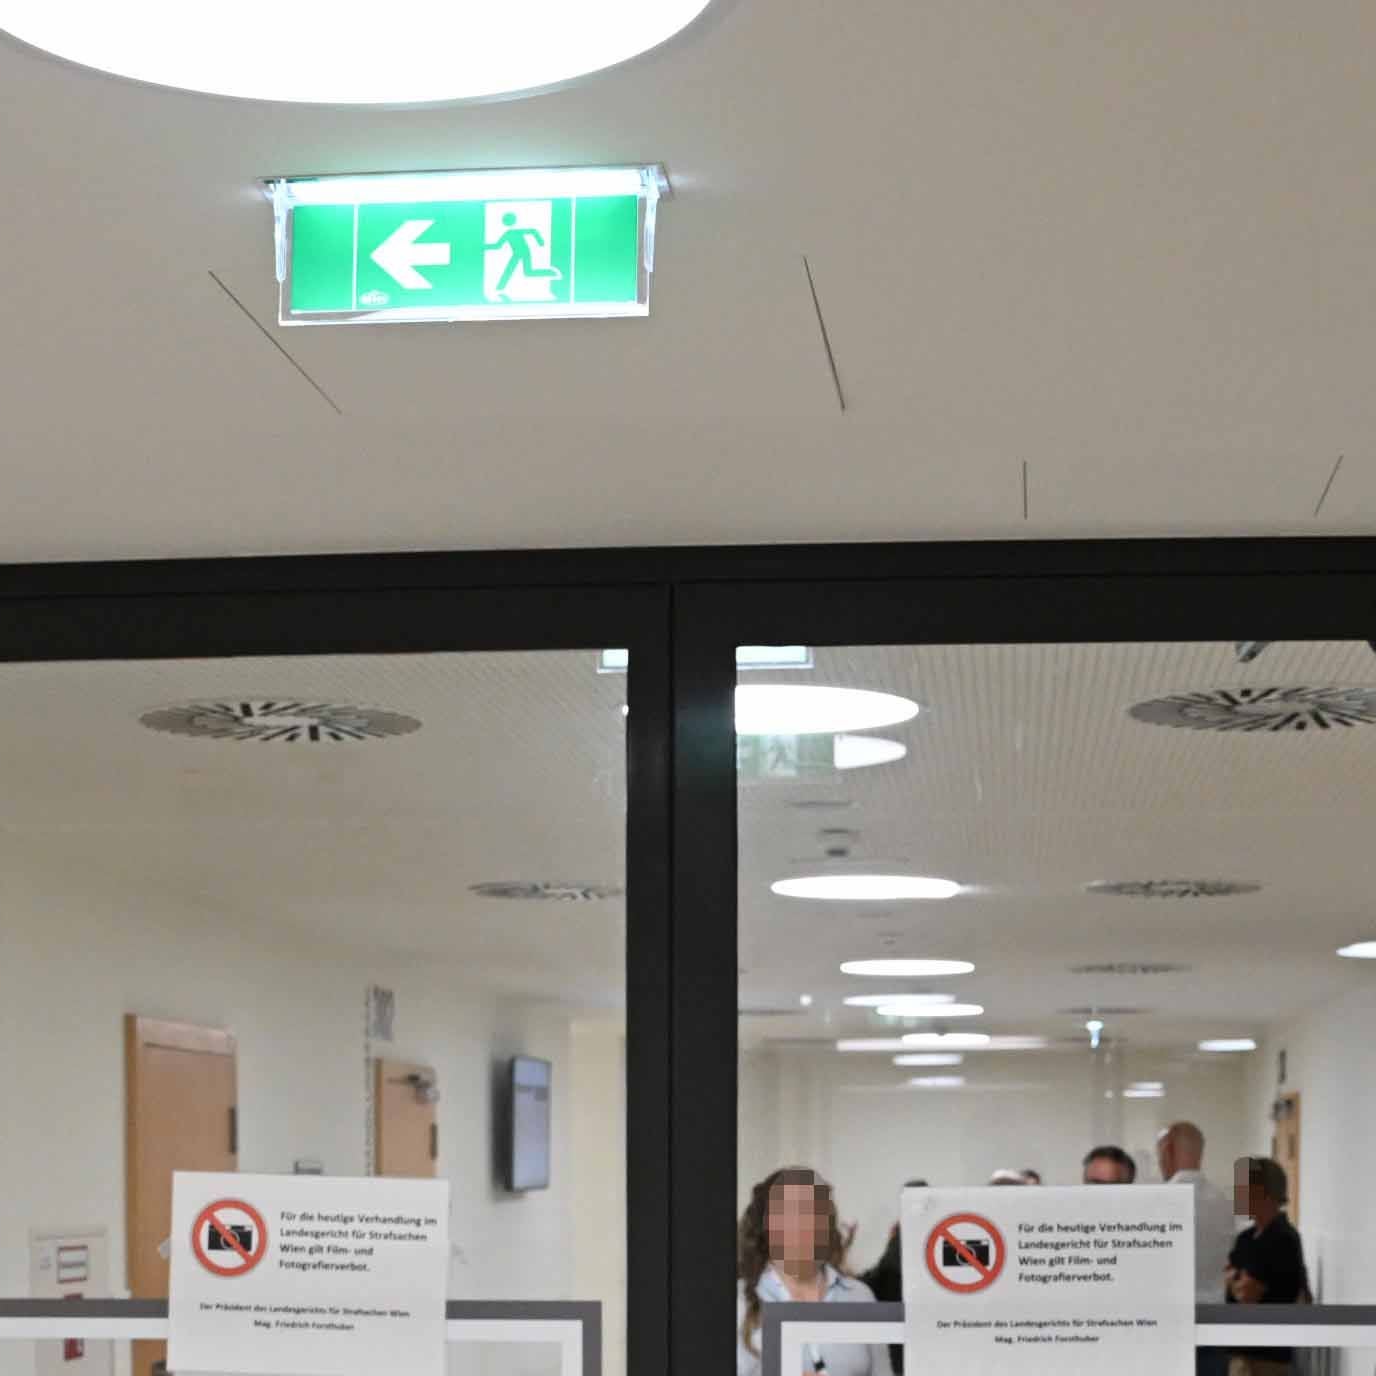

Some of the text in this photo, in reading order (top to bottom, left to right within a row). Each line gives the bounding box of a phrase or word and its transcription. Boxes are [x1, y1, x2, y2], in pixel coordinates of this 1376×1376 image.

[280, 1211, 438, 1227] Für die heutige Verhandlung im
[280, 1228, 428, 1241] Landesgericht für Strafsachen
[1018, 1221, 1183, 1235] Für die heutige Verhandlung im
[279, 1244, 374, 1256] Wien gilt Film- und
[1018, 1237, 1173, 1251] Landesgericht für Strafsachen
[279, 1259, 370, 1272] Fotografierverbot.
[1018, 1255, 1118, 1268] Wien gilt Film- und
[1018, 1271, 1114, 1284] Fotografierverbot.
[275, 1320, 310, 1329] Friedrich
[953, 1319, 992, 1329] Präsident
[994, 1319, 1008, 1328] des
[1010, 1319, 1070, 1329] Landesgerichts
[1072, 1318, 1084, 1327] für
[1087, 1318, 1134, 1328] Strafsachen
[1136, 1318, 1158, 1327] Wien
[994, 1335, 1015, 1345] Mag.
[1017, 1335, 1053, 1344] Friedrich
